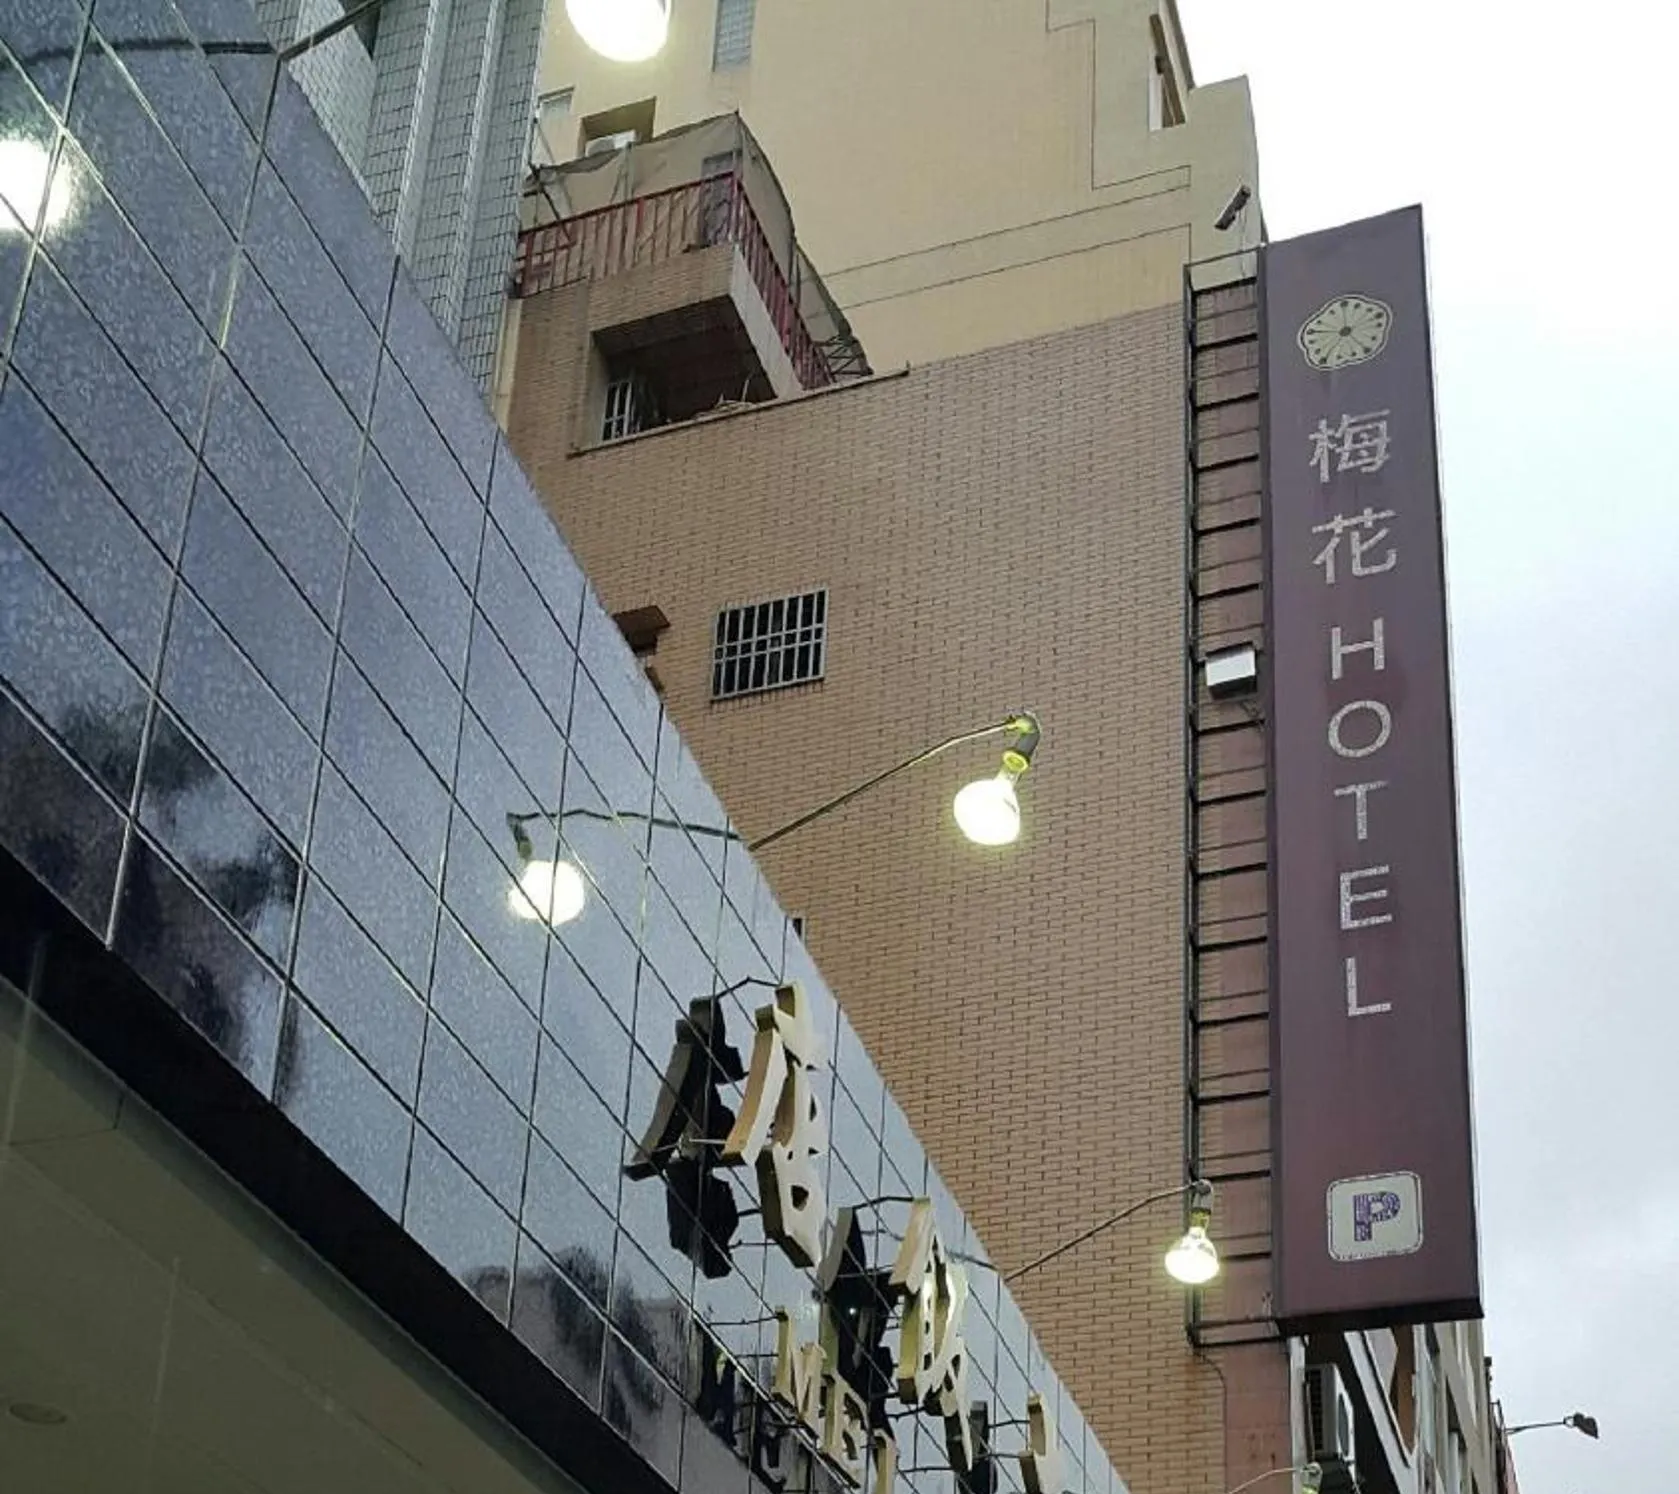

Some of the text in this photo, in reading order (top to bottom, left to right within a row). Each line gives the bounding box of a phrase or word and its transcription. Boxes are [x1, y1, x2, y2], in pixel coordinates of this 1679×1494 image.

[1309, 409, 1396, 1016] 梅花 HOTEL
[1353, 1190, 1401, 1241] P
